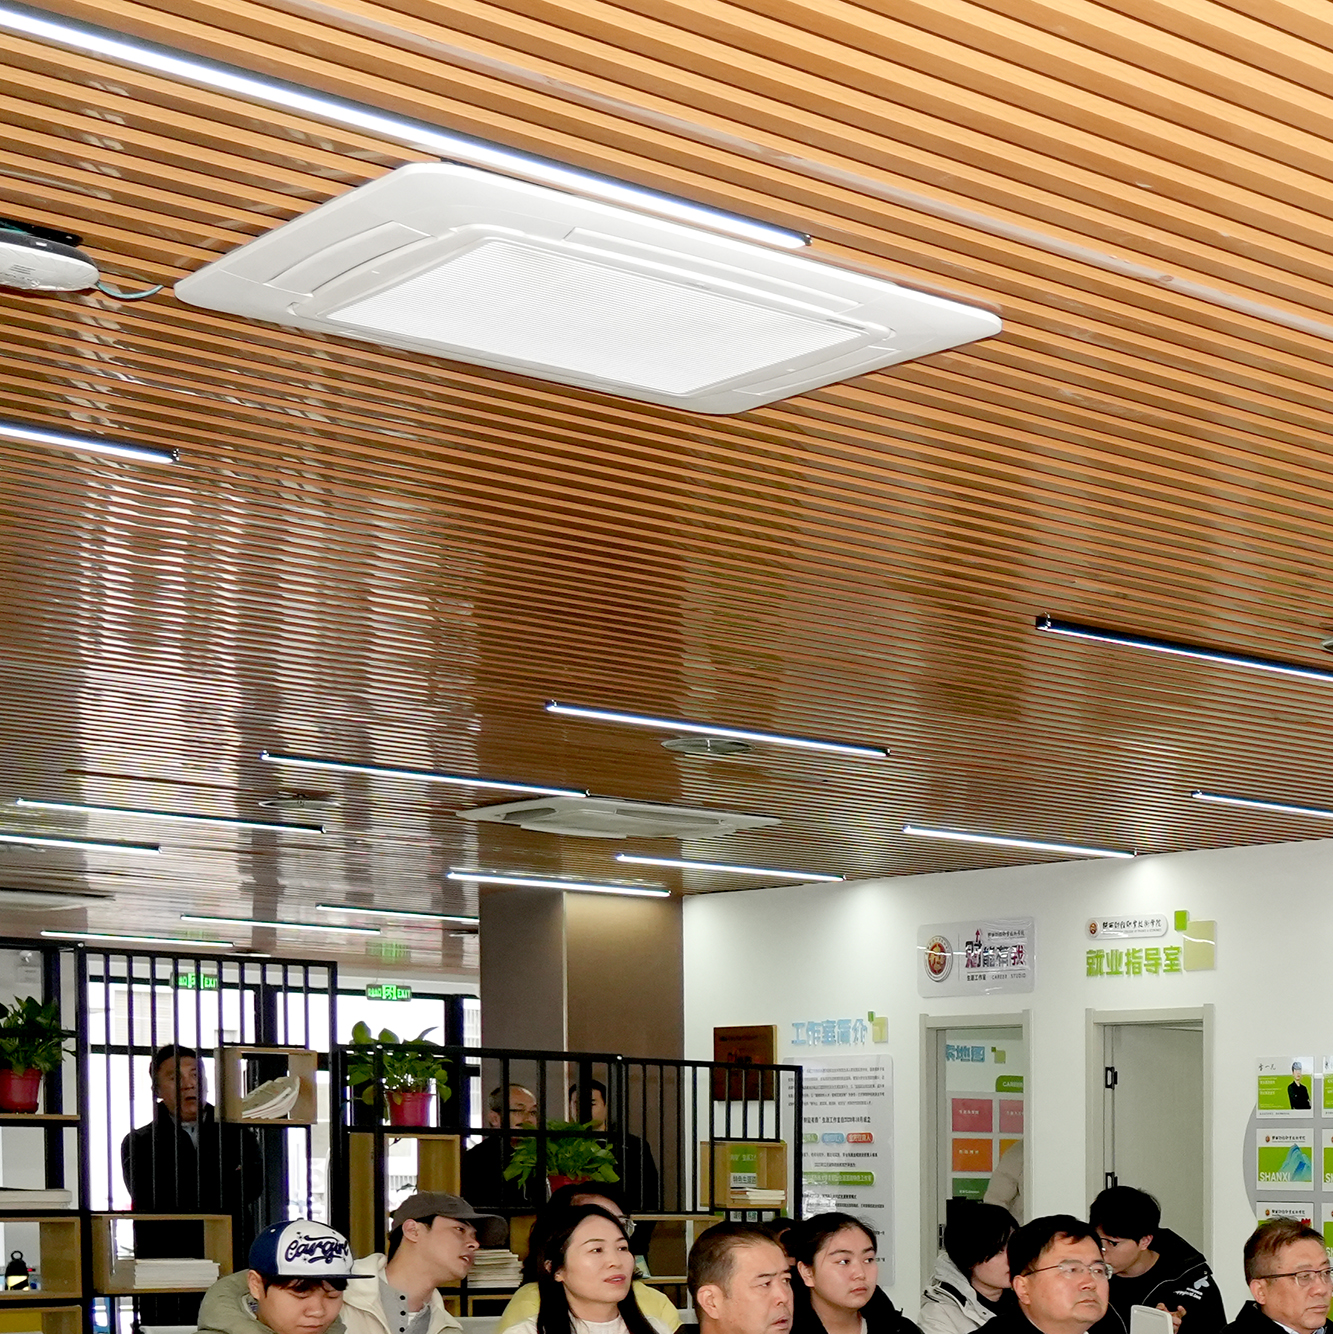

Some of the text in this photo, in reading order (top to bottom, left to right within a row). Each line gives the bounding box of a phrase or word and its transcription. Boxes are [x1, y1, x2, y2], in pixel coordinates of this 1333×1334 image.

[1086, 945, 1181, 977] 就业指导室
[397, 988, 410, 999] EXIT
[1259, 1172, 1290, 1182] SHANXI
